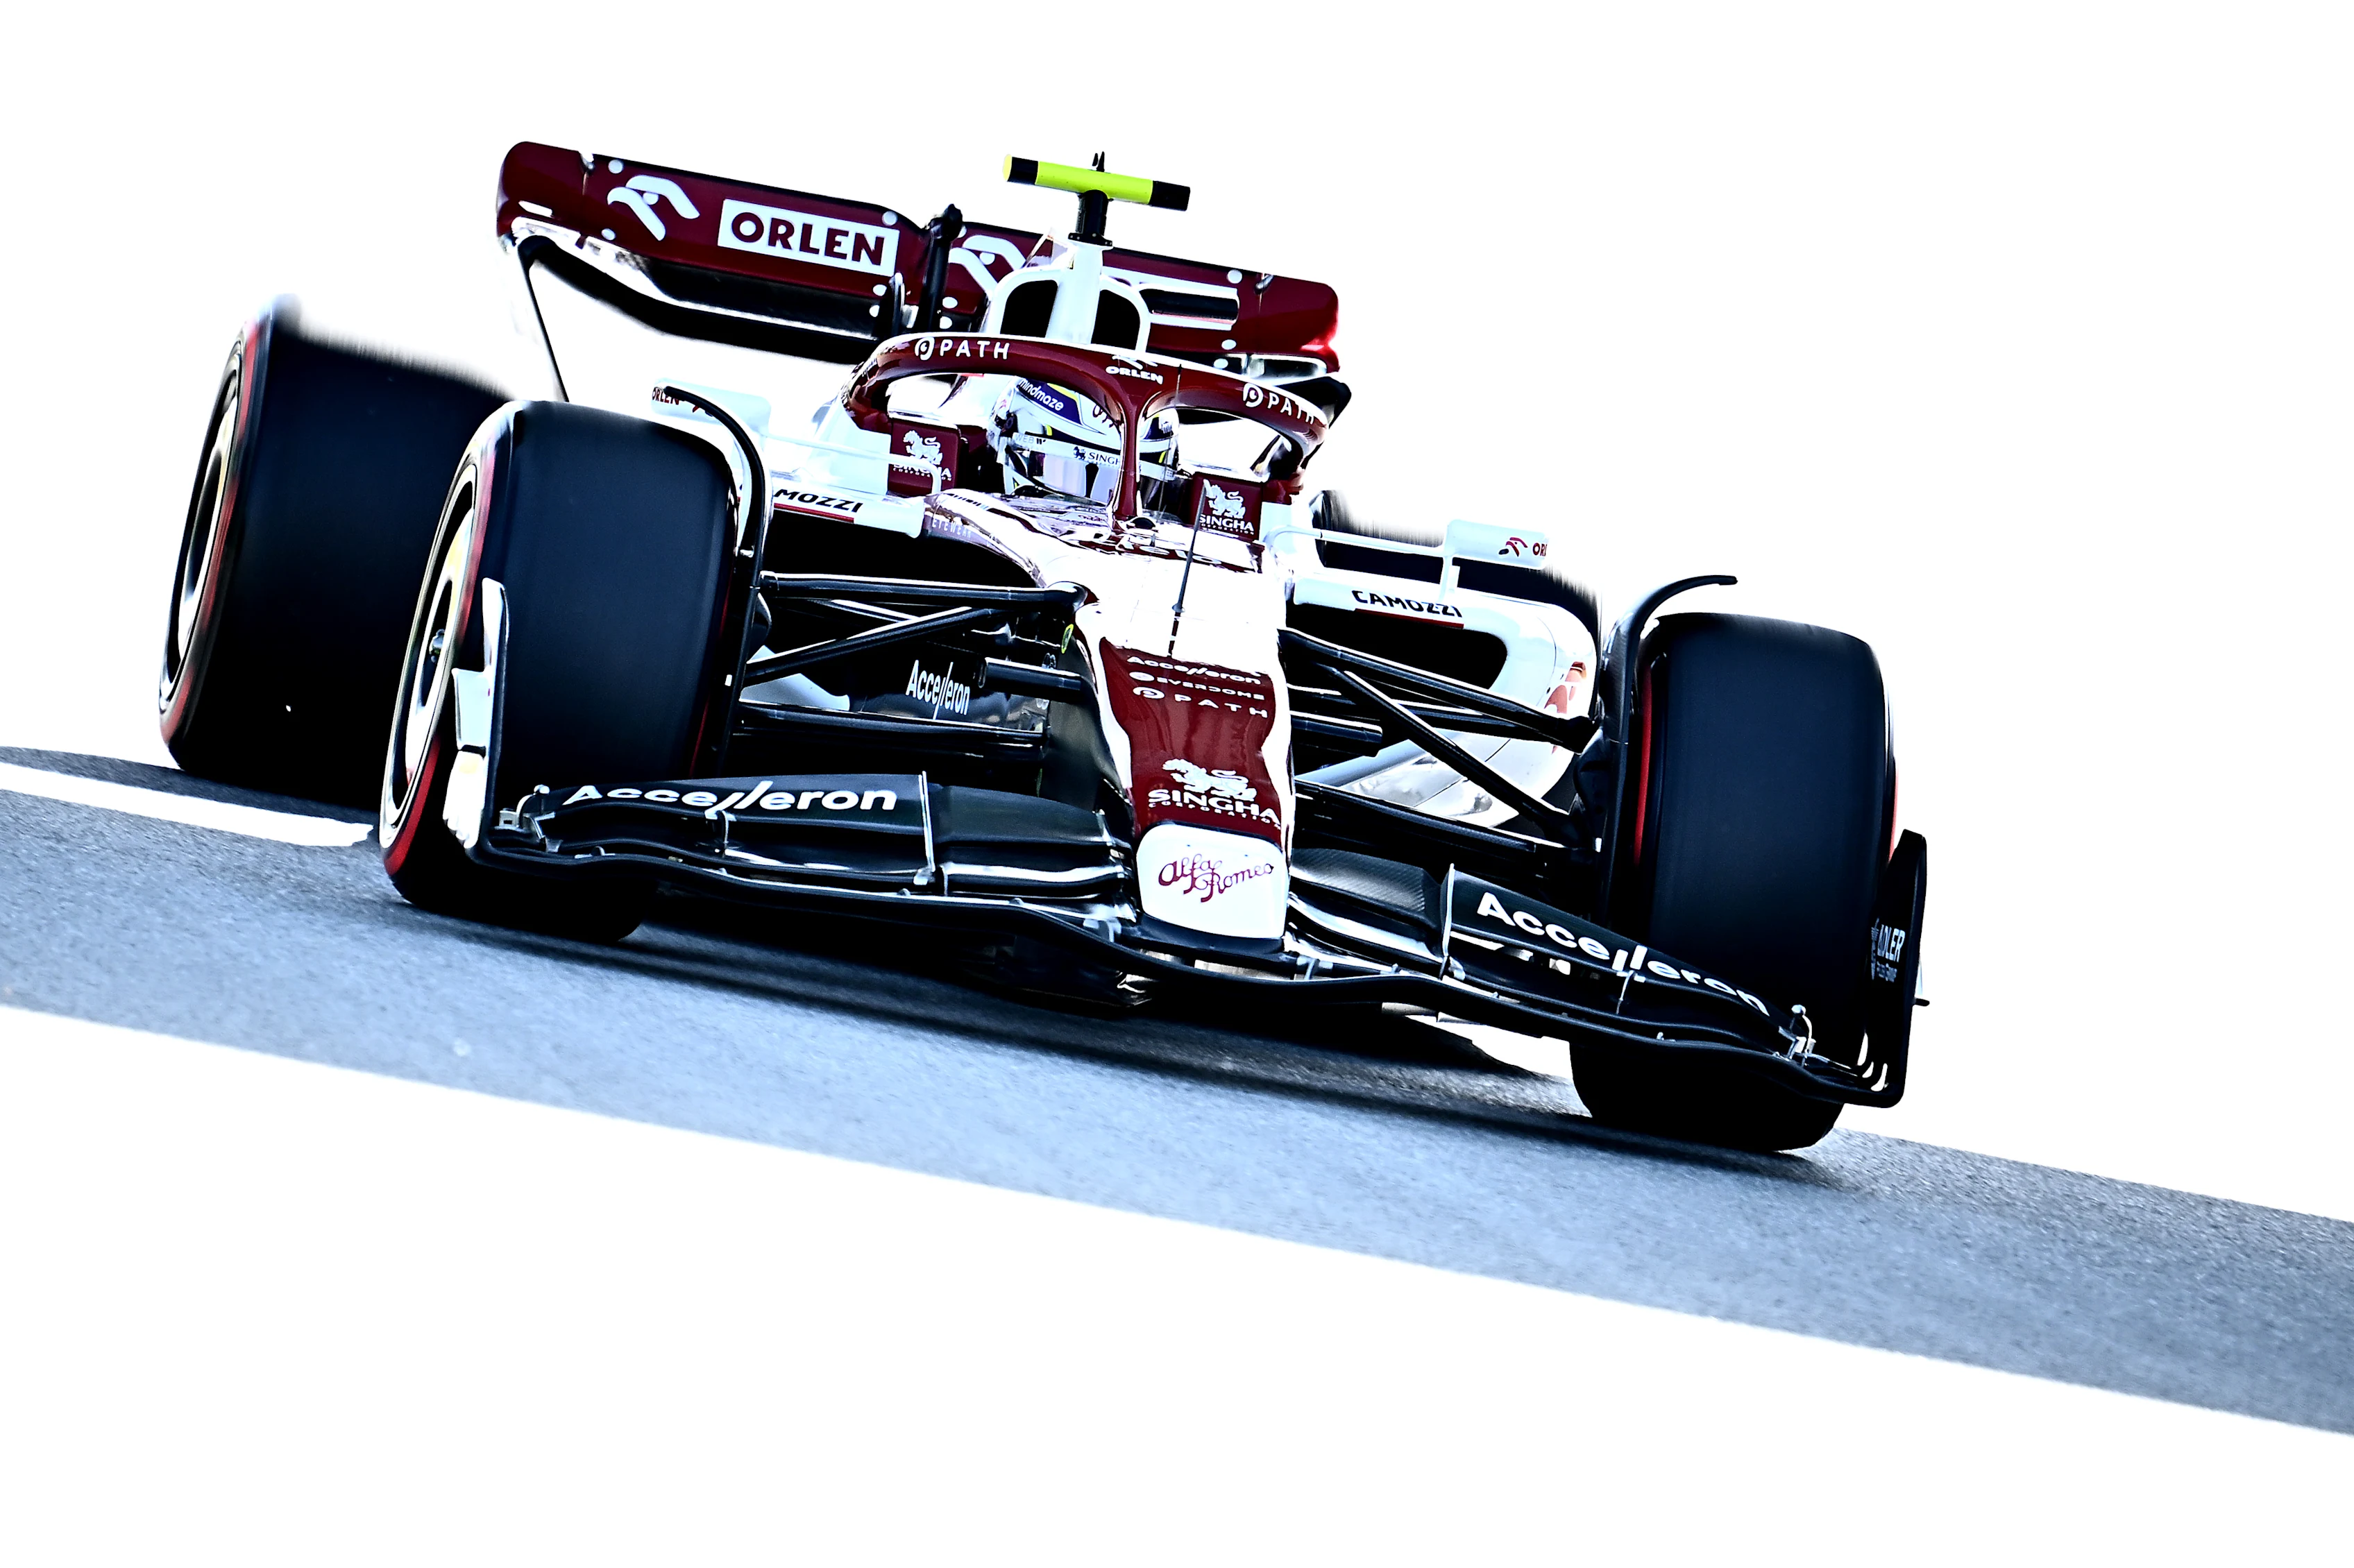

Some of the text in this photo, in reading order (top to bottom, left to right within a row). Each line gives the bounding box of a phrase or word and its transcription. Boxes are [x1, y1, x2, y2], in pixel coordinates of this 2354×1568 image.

[731, 212, 885, 266] ORLEN
[940, 339, 1010, 360] PATH
[1106, 365, 1164, 385] ORLEN
[1018, 378, 1064, 411] mindmaze
[773, 488, 863, 513] MOZZI
[1199, 513, 1255, 532] SINGHA
[1351, 590, 1463, 618] CAMOZZI
[1127, 656, 1262, 685] Accelleron
[905, 659, 971, 720] Accelleron
[1174, 693, 1269, 719] PATH
[562, 781, 897, 821] Accelleron
[1148, 788, 1281, 826] SINGHA
[1158, 853, 1275, 903] Alfa Romeo
[1477, 892, 1770, 1017] Accelleron
